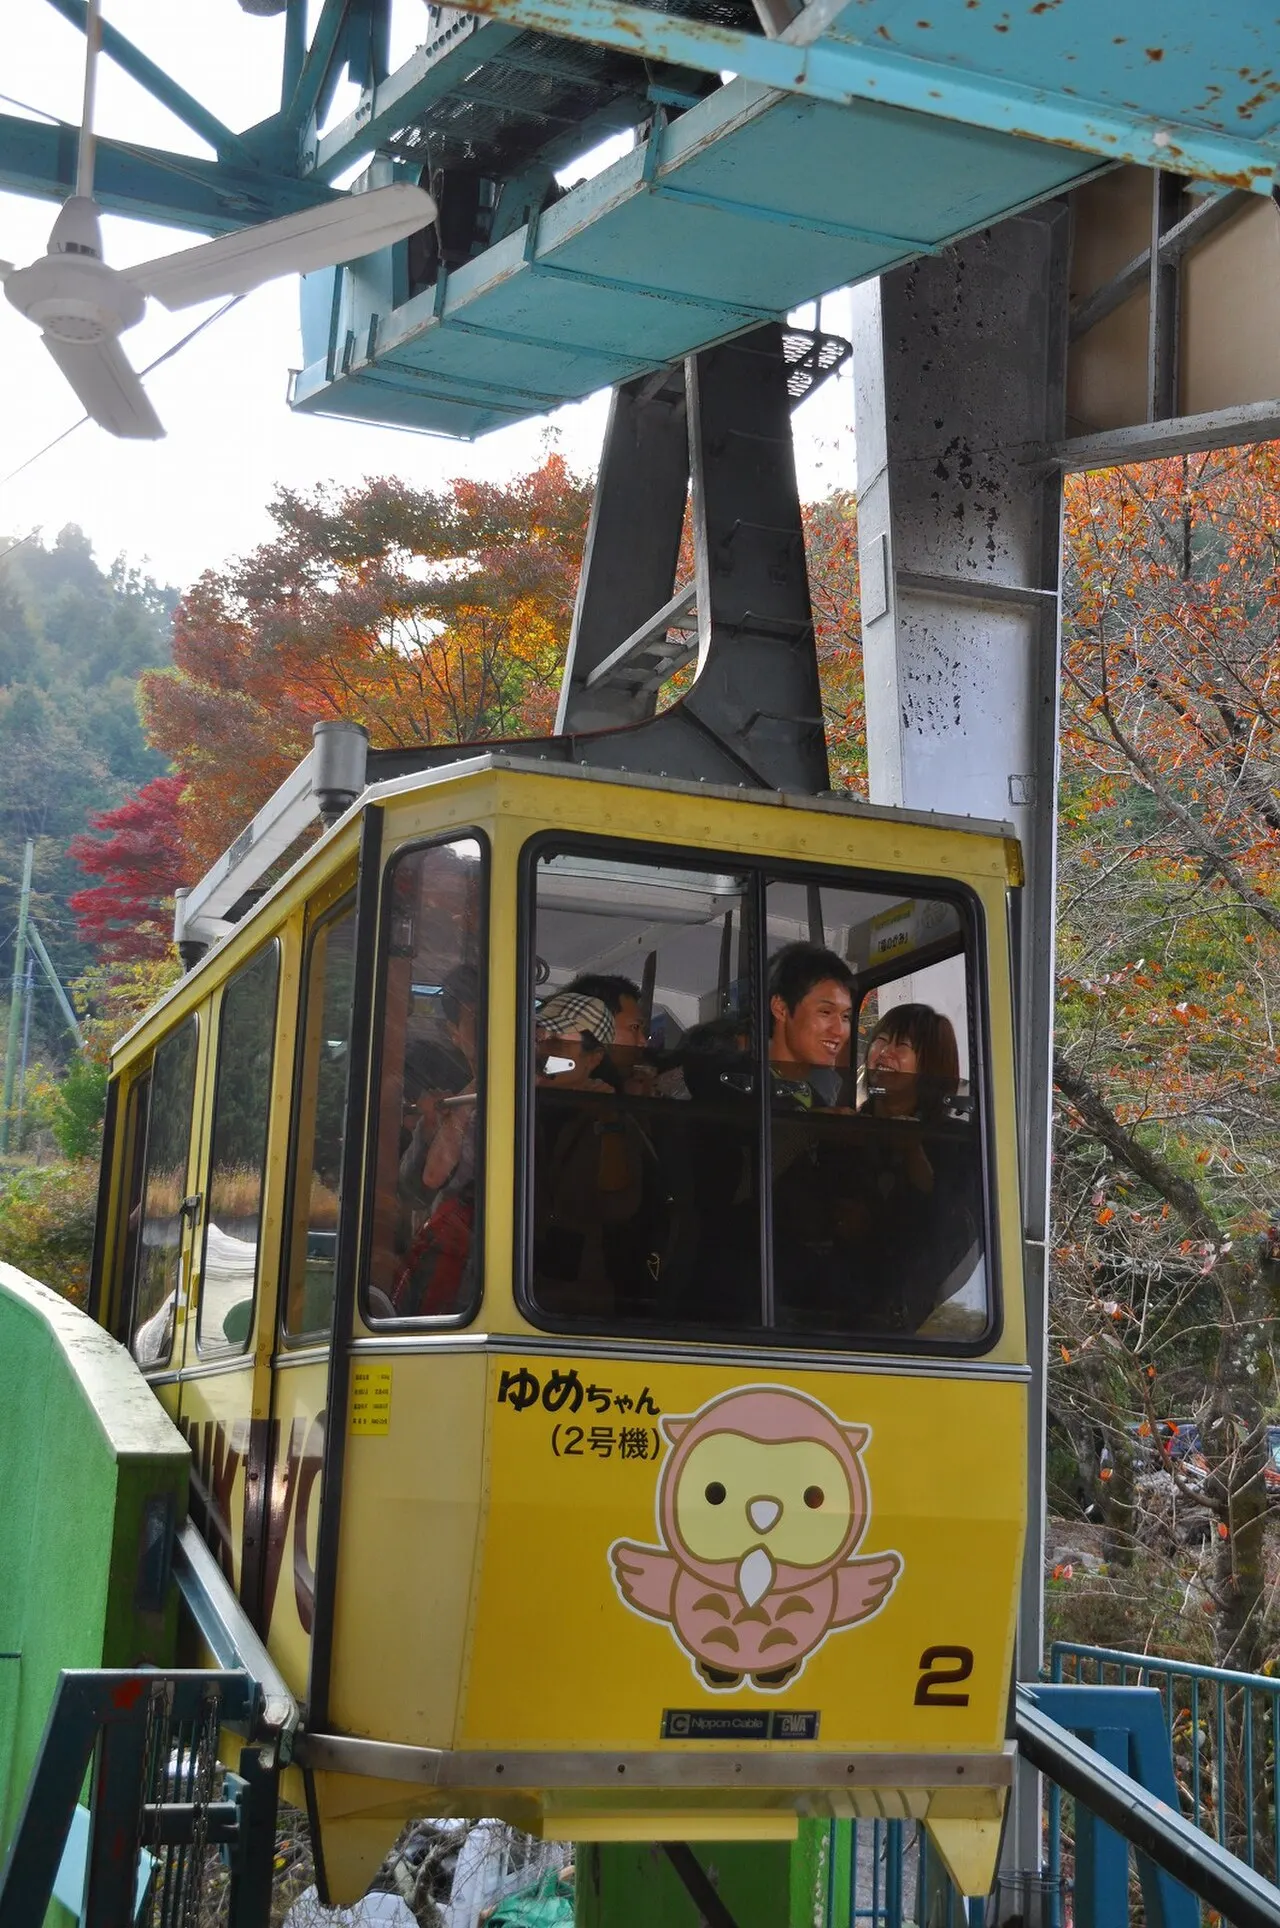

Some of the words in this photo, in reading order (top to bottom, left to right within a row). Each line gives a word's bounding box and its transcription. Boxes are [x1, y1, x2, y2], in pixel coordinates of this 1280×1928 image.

[497, 1367, 661, 1415] ゆめちゃん
[552, 1424, 661, 1460] (2号機)
[914, 1645, 974, 1706] 2
[691, 1717, 731, 1729] Nippon
[731, 1717, 764, 1729] Cable
[780, 1715, 807, 1732] CWA
